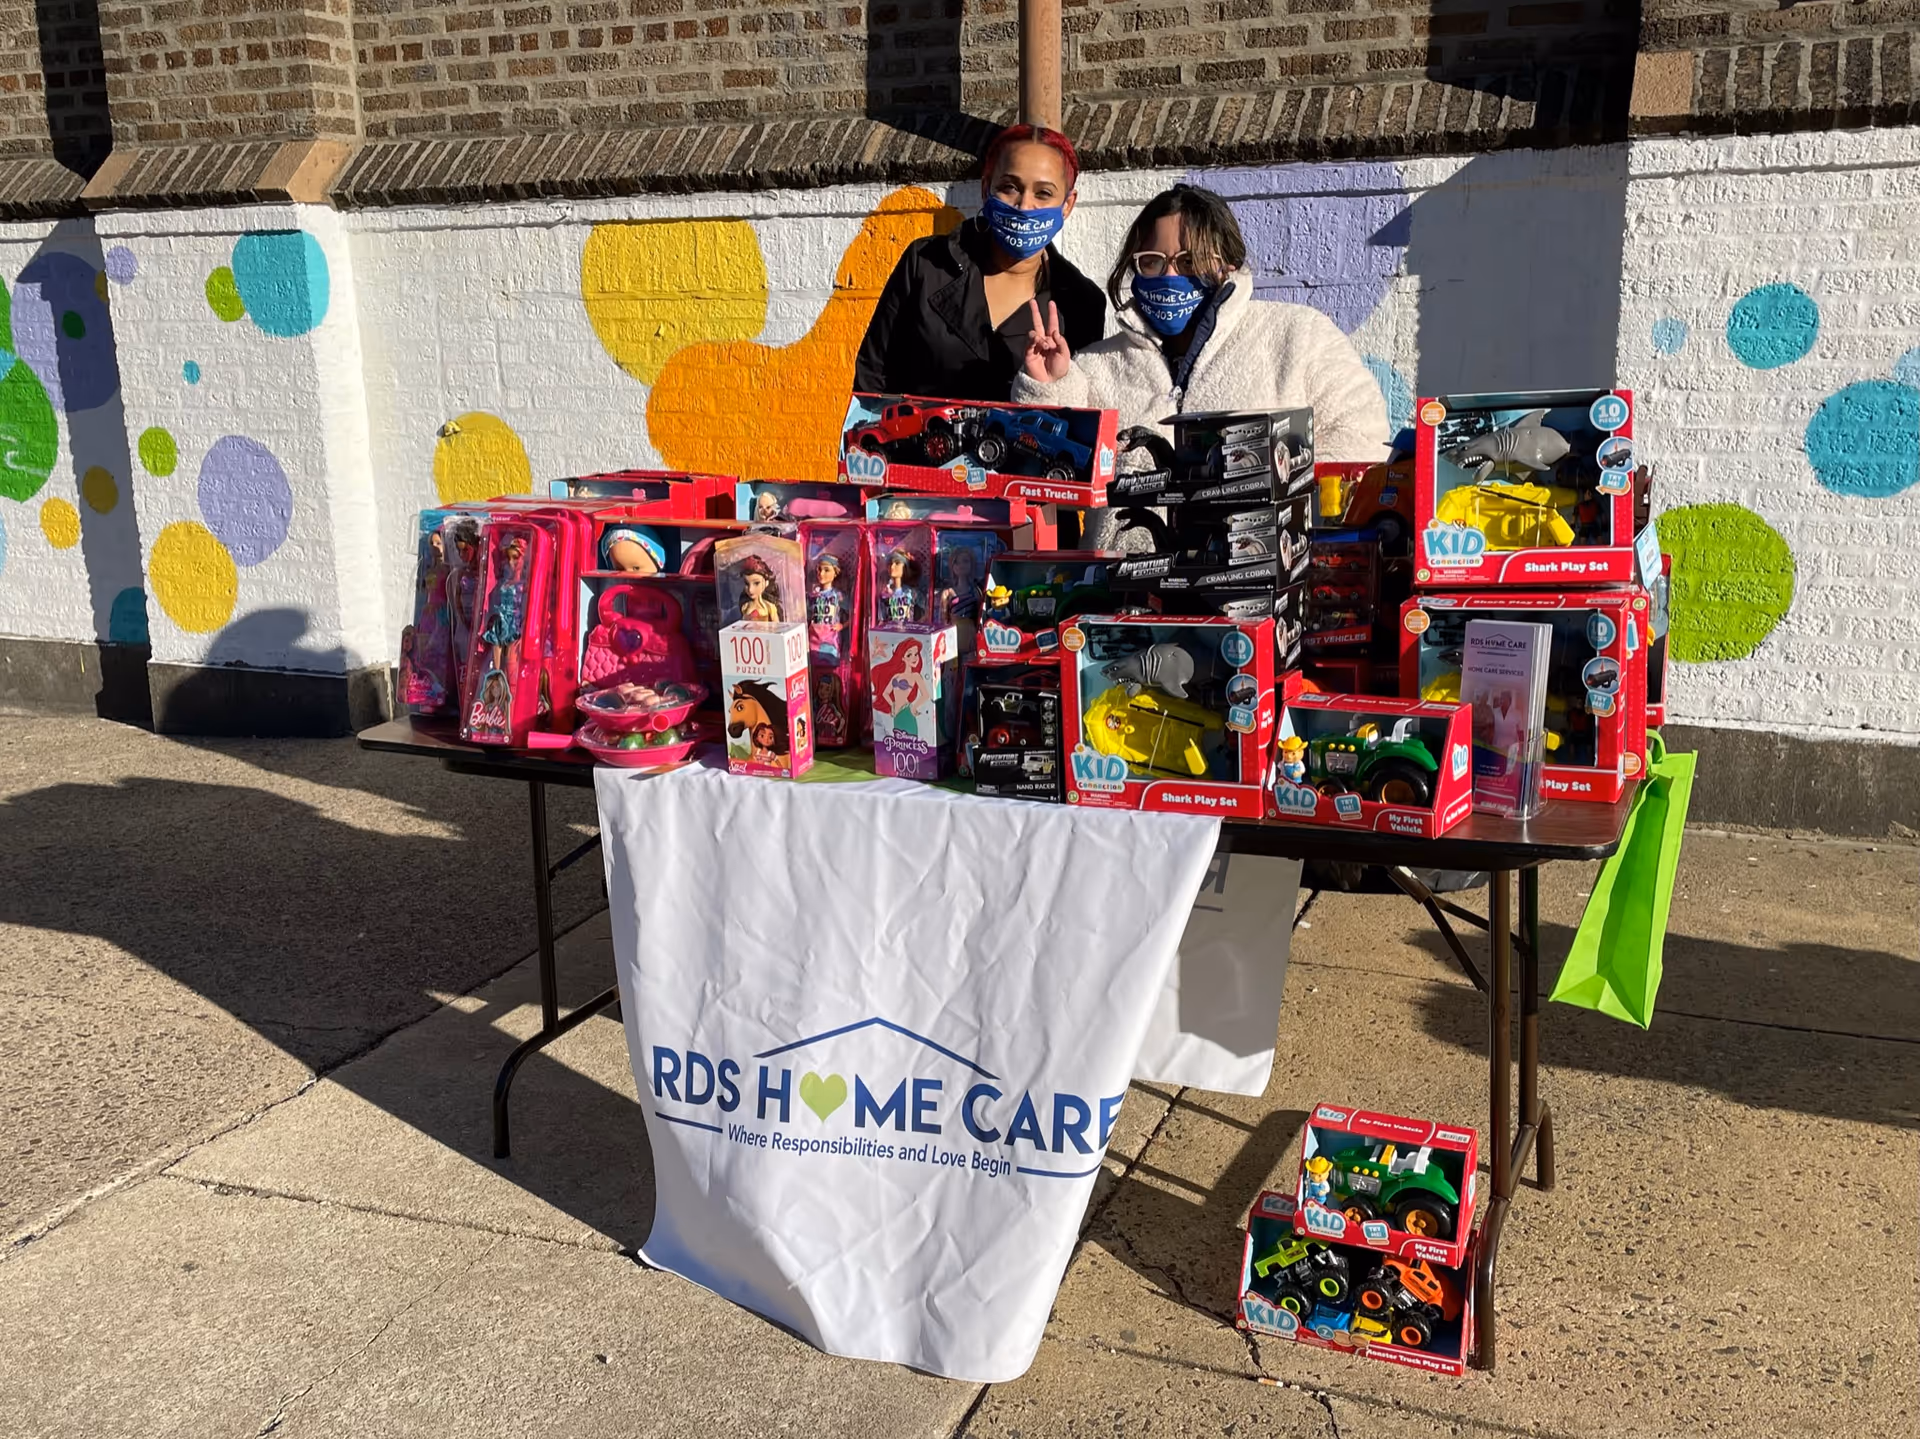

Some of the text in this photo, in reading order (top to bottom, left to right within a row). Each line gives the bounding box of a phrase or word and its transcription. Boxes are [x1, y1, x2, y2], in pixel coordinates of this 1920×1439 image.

[1598, 403, 1620, 418] 10
[848, 455, 885, 477] KID
[1020, 485, 1079, 500] Fast Trucks
[1201, 481, 1266, 498] CRAWLING COBRA
[1426, 530, 1484, 556] KID
[1117, 558, 1169, 575] ADVENTURE
[1525, 561, 1609, 573] Shark Play Set
[1206, 568, 1271, 583] CRAWLING COBRA
[985, 628, 1020, 646] KID
[1324, 633, 1367, 643] VEHICLES
[1508, 640, 1527, 649] CARE
[730, 635, 764, 665] 100
[1227, 639, 1246, 654] 10
[736, 666, 766, 675] PUZZLE
[1484, 667, 1498, 675] CARE
[1499, 669, 1524, 677] SERVICES
[469, 701, 506, 727] Barbie
[892, 752, 916, 774] 100
[979, 753, 1019, 764] ADVENTURE
[1453, 746, 1468, 772] KID
[1074, 754, 1124, 781] KID
[1078, 781, 1122, 791] Connection
[1545, 779, 1591, 792] Play Set
[1161, 792, 1238, 807] Shark Play Set
[1276, 786, 1316, 808] KID
[1389, 814, 1423, 825] My First
[1390, 823, 1422, 834] Vehicle
[653, 1046, 741, 1113] RDS
[961, 1083, 1127, 1155] CARE
[1318, 1109, 1346, 1120] KID
[1373, 1119, 1392, 1128] First
[1393, 1123, 1424, 1133] Vehicle
[728, 1122, 1012, 1178] Where Responsibilities and Love Begin
[1306, 1208, 1344, 1231] KID
[1415, 1242, 1447, 1255] My First
[1416, 1251, 1447, 1263] Vehicle
[1244, 1300, 1296, 1331] KID
[1399, 1355, 1421, 1365] Truck
[1422, 1360, 1439, 1369] Play
[1441, 1364, 1455, 1372] Set
